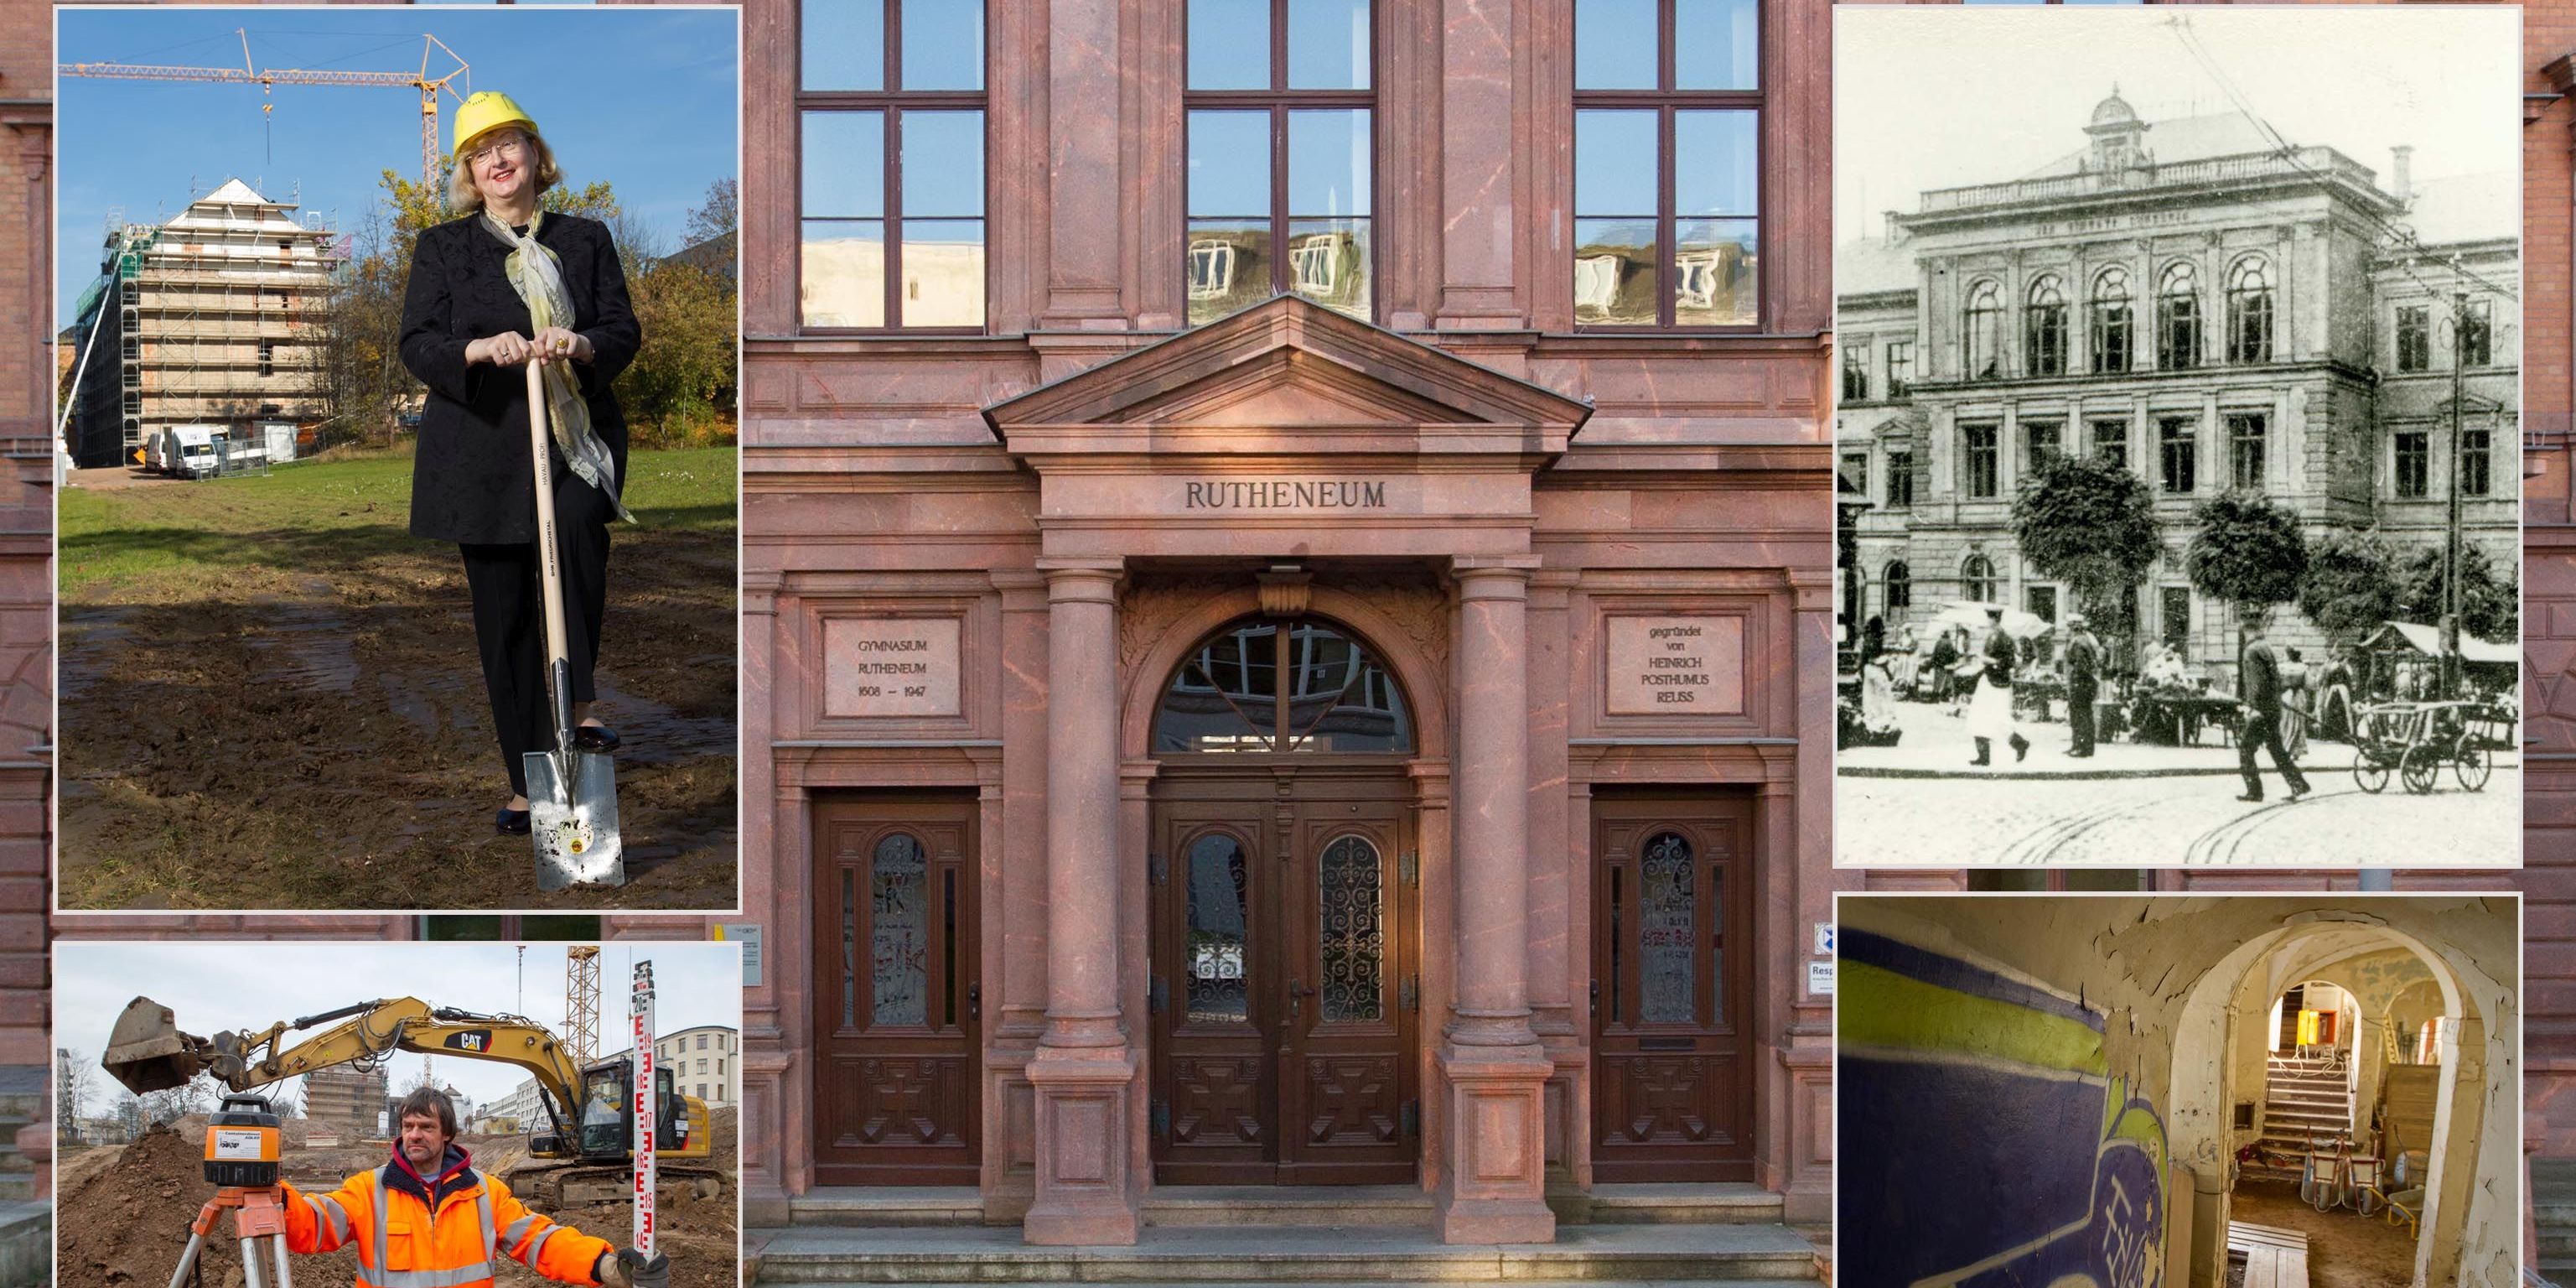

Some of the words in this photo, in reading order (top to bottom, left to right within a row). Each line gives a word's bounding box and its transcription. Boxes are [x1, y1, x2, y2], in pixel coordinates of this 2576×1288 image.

[1186, 481, 1386, 508] RUTHENEUM
[1650, 626, 1702, 639] gegründet
[858, 641, 927, 652] GYMNASIUM
[1666, 642, 1685, 651] von
[858, 663, 926, 674] RUTHENEUM
[1649, 657, 1702, 668] HEINRICH
[1641, 674, 1709, 685] POSTHUMUS
[858, 686, 880, 697] 1608
[904, 686, 926, 697] 1947
[1656, 692, 1694, 703] REUSS
[461, 1033, 481, 1051] CAT
[635, 1072, 644, 1090] 18
[645, 1112, 652, 1129] 17
[636, 1152, 644, 1169] 16
[645, 1192, 653, 1209] 15
[635, 1232, 644, 1249] 14
